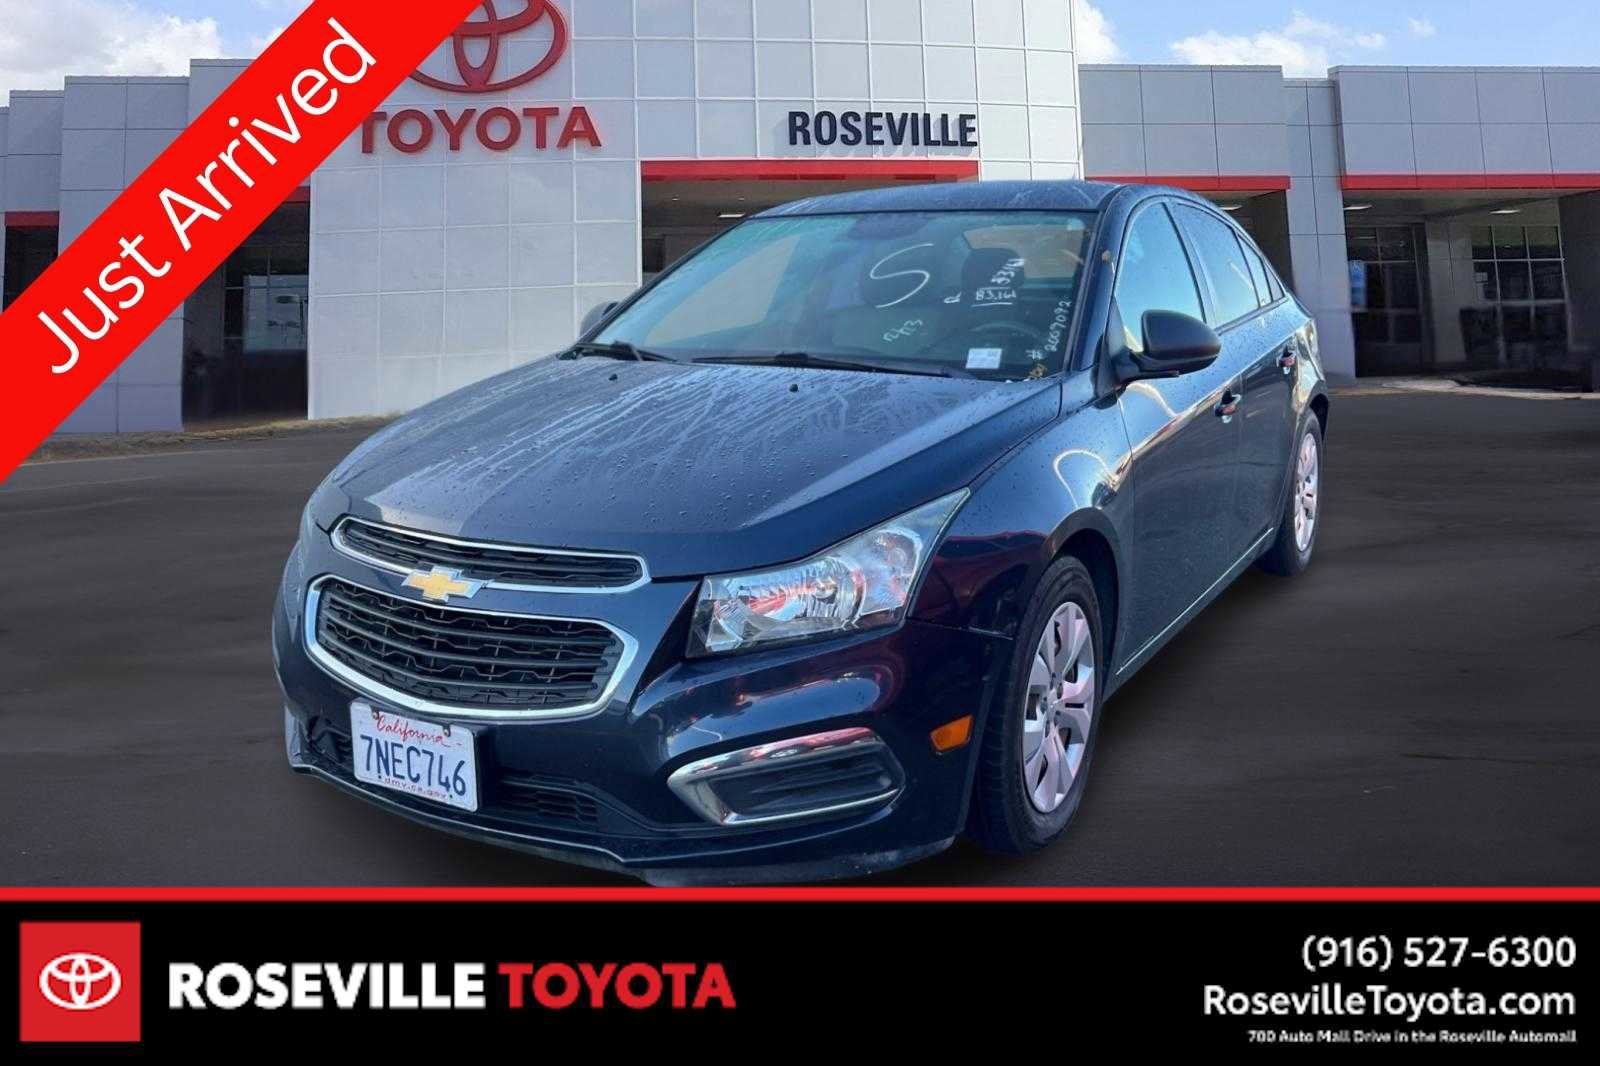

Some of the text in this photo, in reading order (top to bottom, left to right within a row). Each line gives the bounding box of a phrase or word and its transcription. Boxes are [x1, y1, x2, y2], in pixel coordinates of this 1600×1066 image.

[358, 106, 602, 154] TOYOTA
[788, 110, 978, 147] ROSEVILLE
[376, 714, 452, 748] California
[360, 734, 467, 797] 7NEC746
